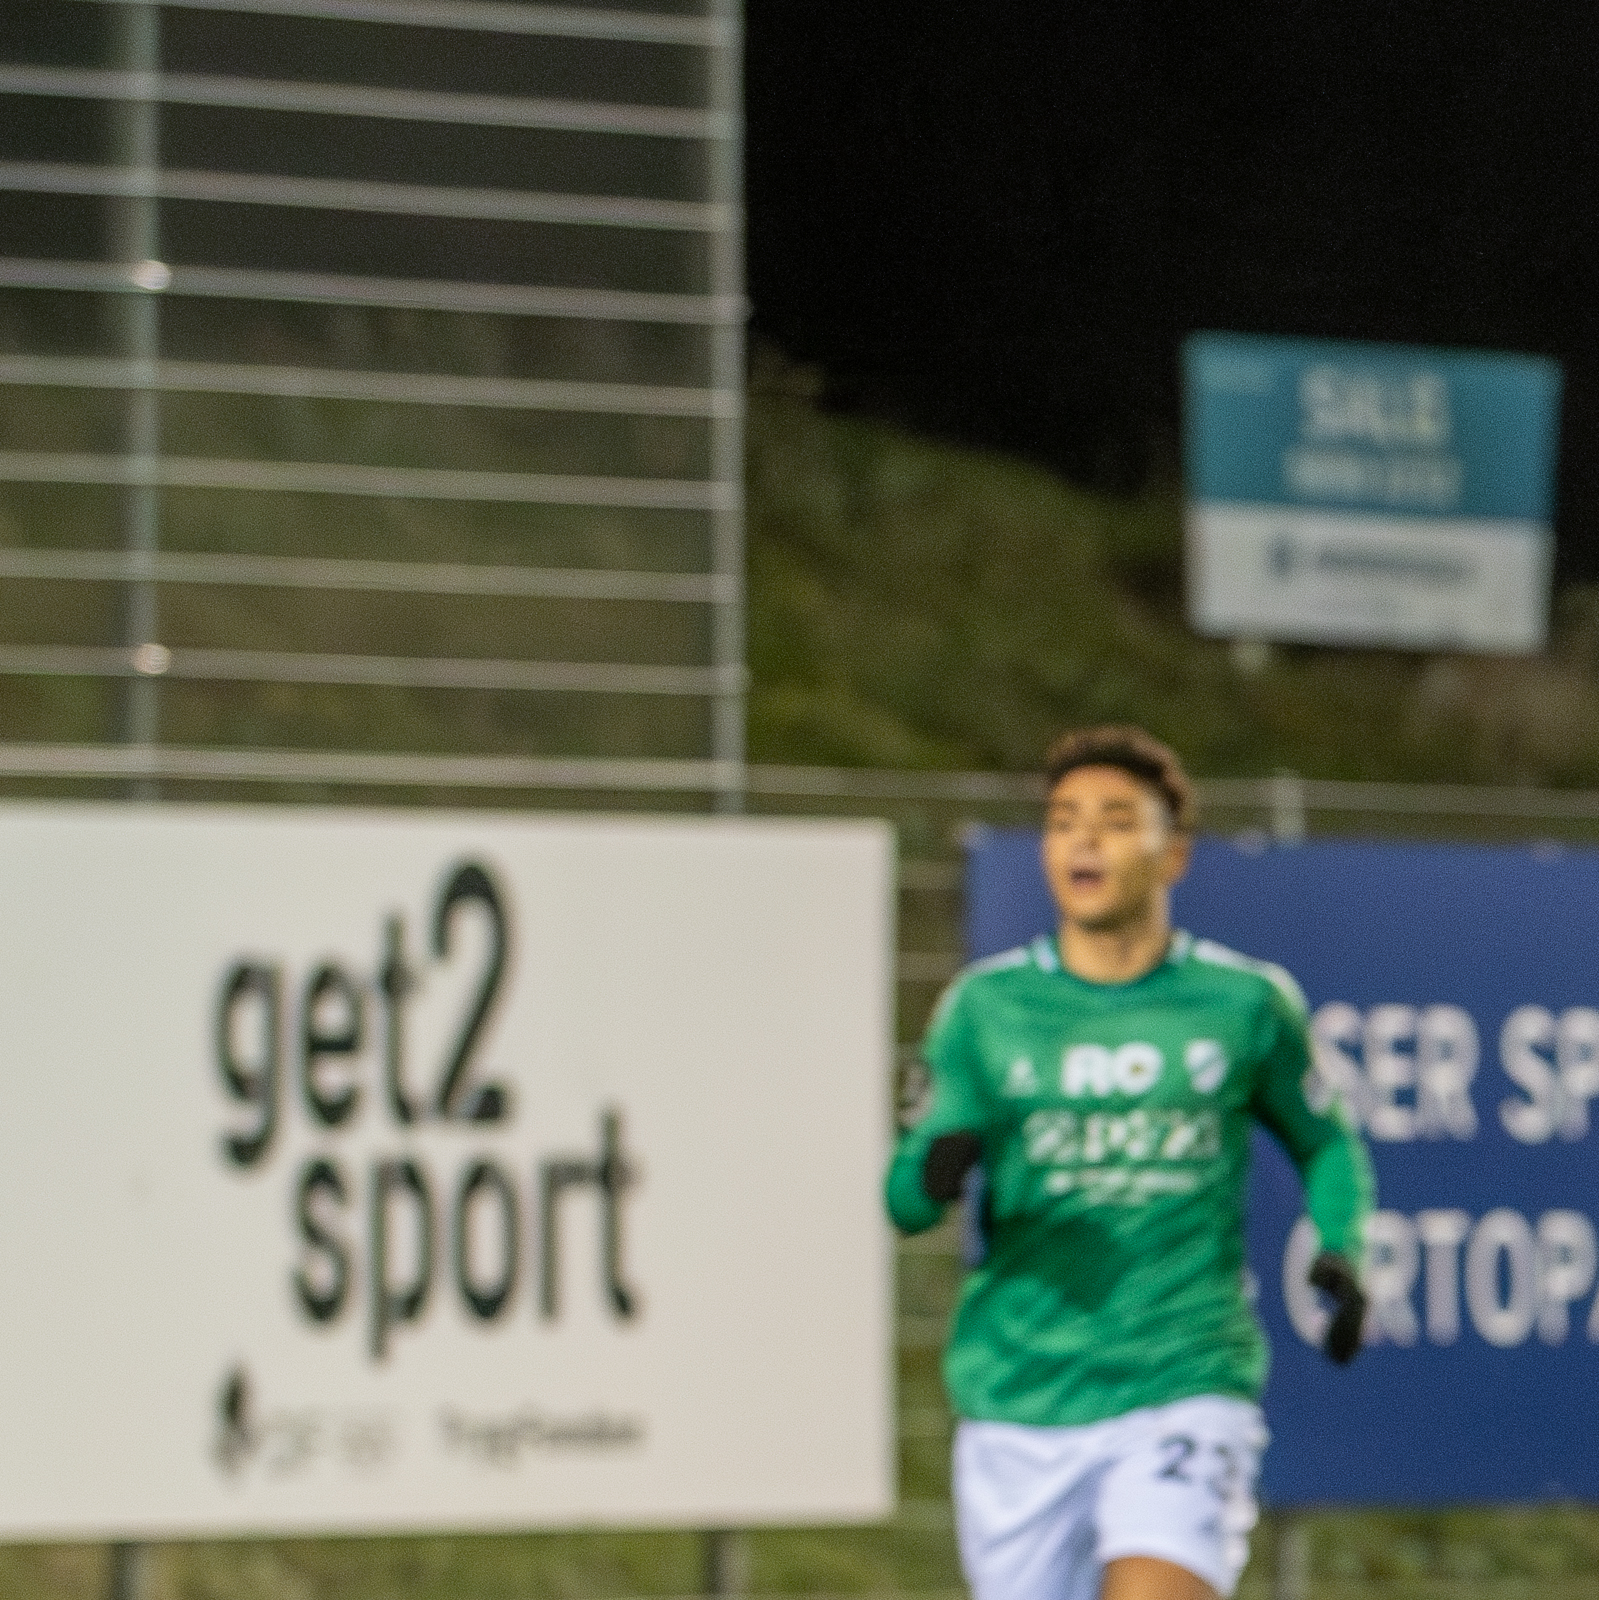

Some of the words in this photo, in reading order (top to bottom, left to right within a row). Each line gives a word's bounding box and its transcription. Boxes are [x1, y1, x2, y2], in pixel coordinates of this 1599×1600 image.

[213, 852, 516, 1170] get2
[1305, 1002, 1480, 1142] SER
[291, 1103, 642, 1364] sport
